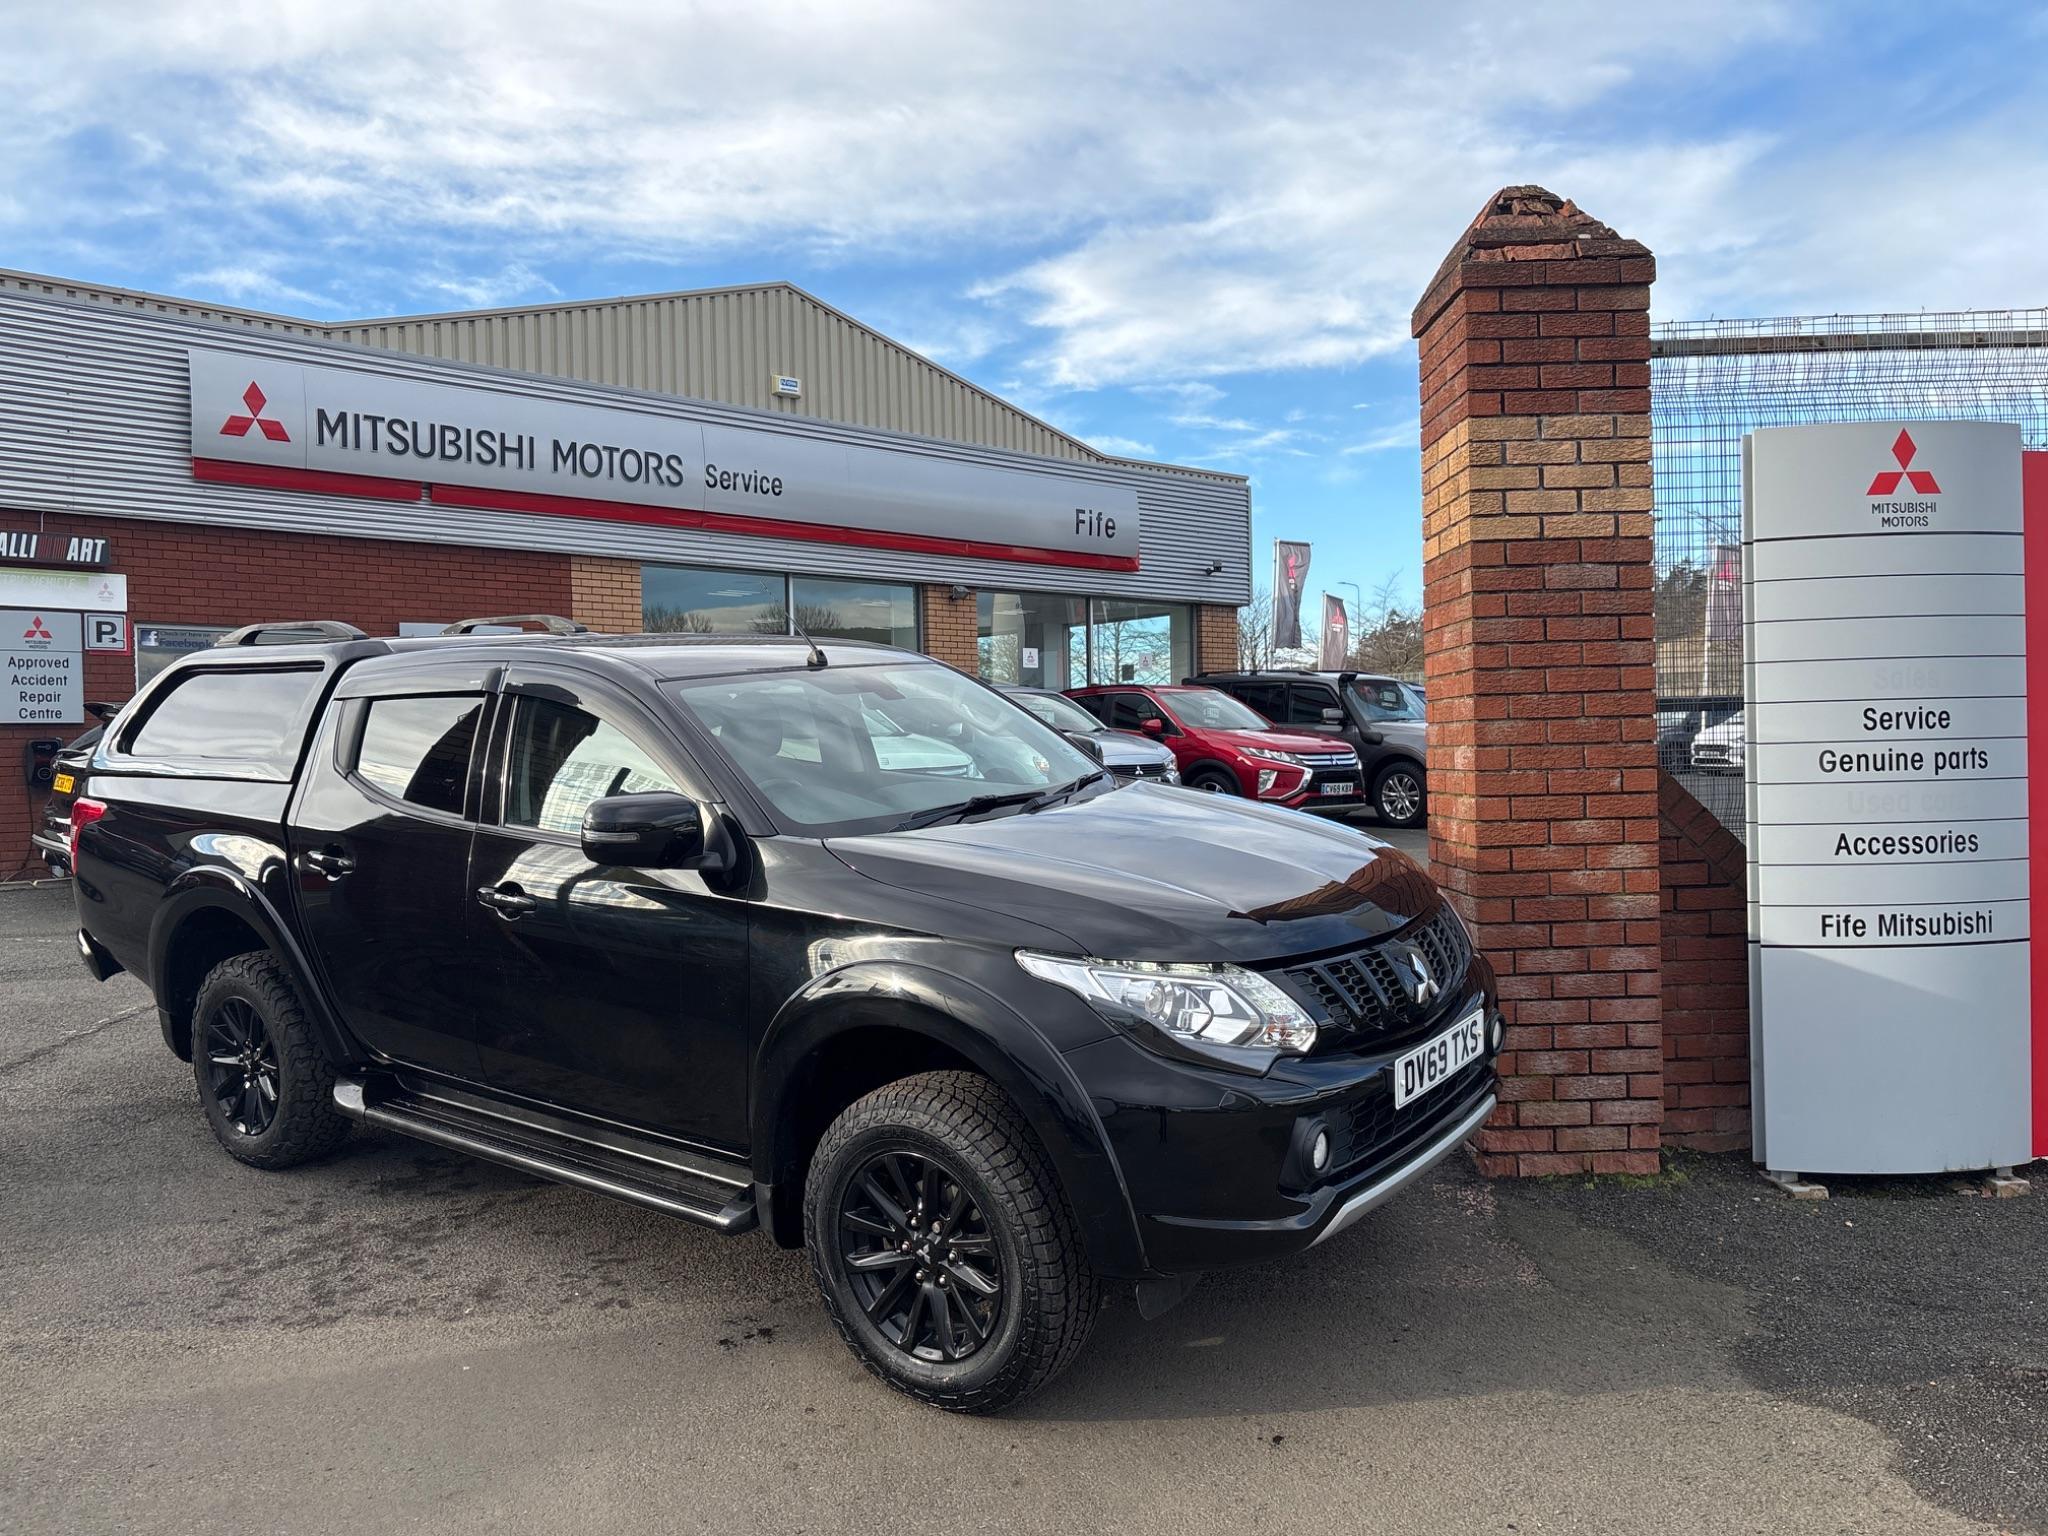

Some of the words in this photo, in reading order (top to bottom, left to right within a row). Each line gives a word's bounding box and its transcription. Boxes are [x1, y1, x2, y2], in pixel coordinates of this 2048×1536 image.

[316, 407, 535, 471] MITSUBISHI
[551, 438, 684, 487] MOTORS
[705, 463, 783, 497] Service
[1871, 502, 1937, 514] MITSUBISHI
[1075, 508, 1116, 539] Fife
[1881, 516, 1929, 527] MOTORS
[66, 537, 106, 563] ART
[95, 620, 117, 643] P
[7, 656, 70, 671] Approved
[11, 674, 68, 686] Accident
[19, 690, 62, 705] Repair
[18, 707, 63, 719] Centre
[1863, 706, 1951, 731] Service
[1818, 748, 1924, 773] Genuine
[1934, 747, 1989, 776] parts
[1834, 830, 1979, 856] Accessories
[1821, 913, 1867, 938] Fife
[1878, 910, 1992, 937] Mitsubishi
[1404, 1039, 1448, 1098] DV69
[1451, 1020, 1478, 1066] TXS
